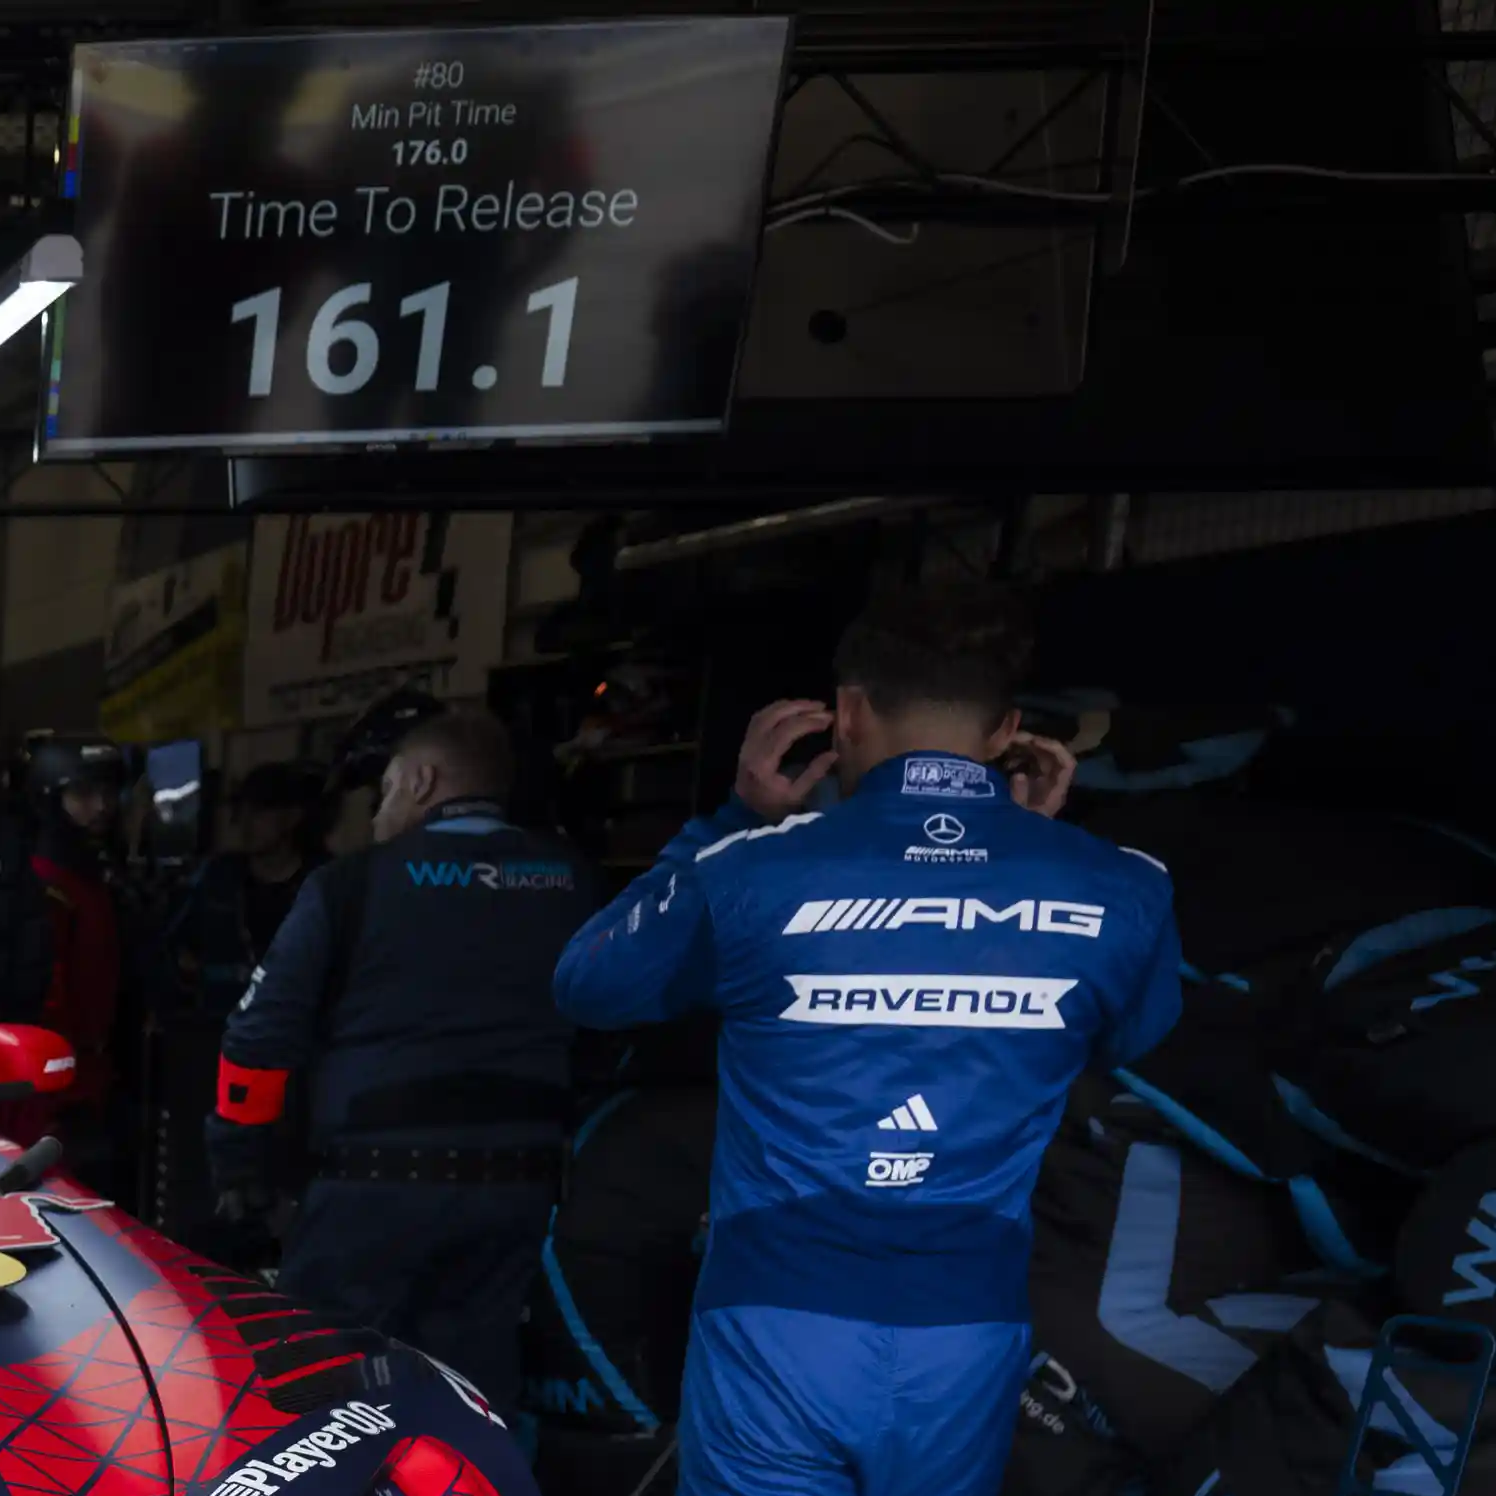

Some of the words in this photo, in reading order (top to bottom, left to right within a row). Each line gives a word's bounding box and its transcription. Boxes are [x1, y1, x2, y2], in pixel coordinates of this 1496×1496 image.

[412, 61, 465, 90] #80
[350, 101, 401, 131] Min
[407, 101, 443, 129] Pit
[451, 99, 518, 127] Time
[391, 139, 470, 168] 176.0
[208, 189, 337, 241] Time
[354, 184, 417, 235] To
[433, 179, 639, 235] Release
[230, 275, 579, 398] 161.1
[885, 896, 1106, 939] AMG
[807, 987, 1045, 1016] RAVENOL
[866, 1156, 931, 1183] OMP
